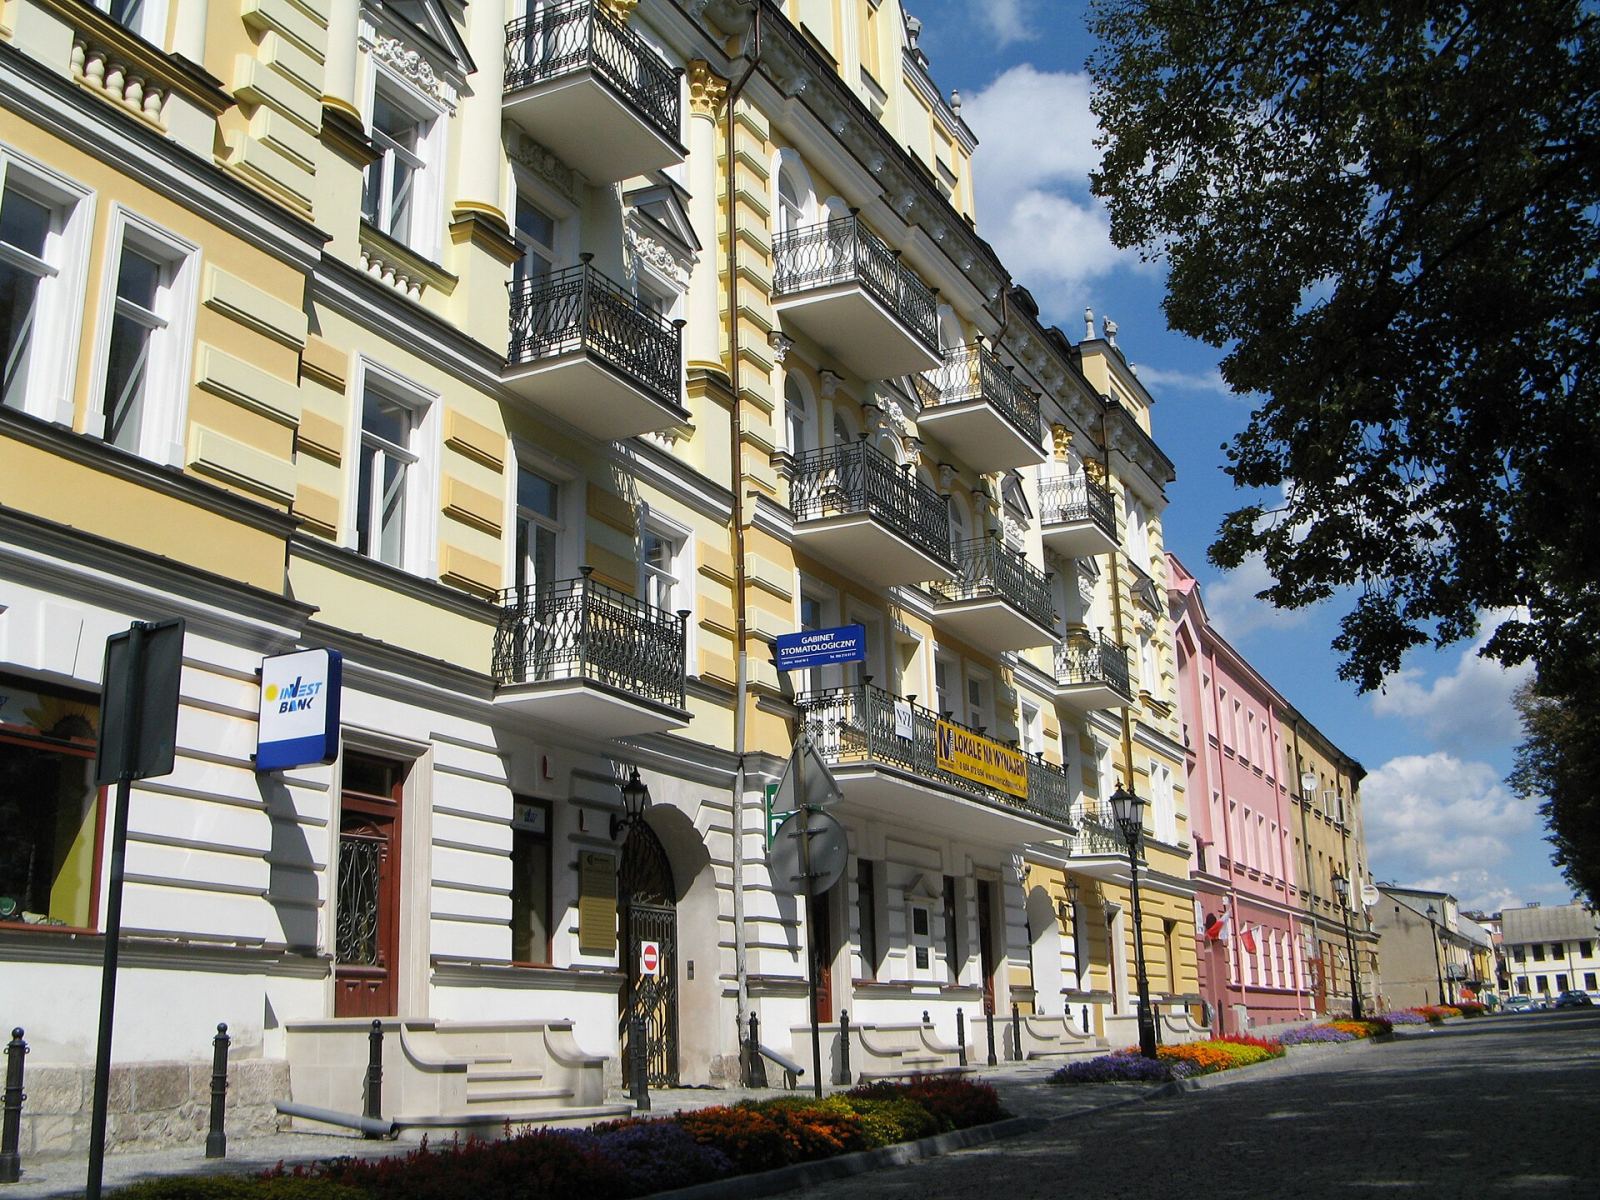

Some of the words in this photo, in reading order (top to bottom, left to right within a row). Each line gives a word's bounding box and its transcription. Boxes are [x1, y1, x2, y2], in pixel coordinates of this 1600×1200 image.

[801, 633, 835, 644] GABINET
[781, 639, 856, 656] STOMATOLOGICZNY
[279, 676, 322, 699] INVEST
[279, 697, 314, 714] BANK
[955, 734, 982, 760] LOKALE
[983, 744, 993, 766] NA
[993, 751, 1026, 777] WYNAJEM
